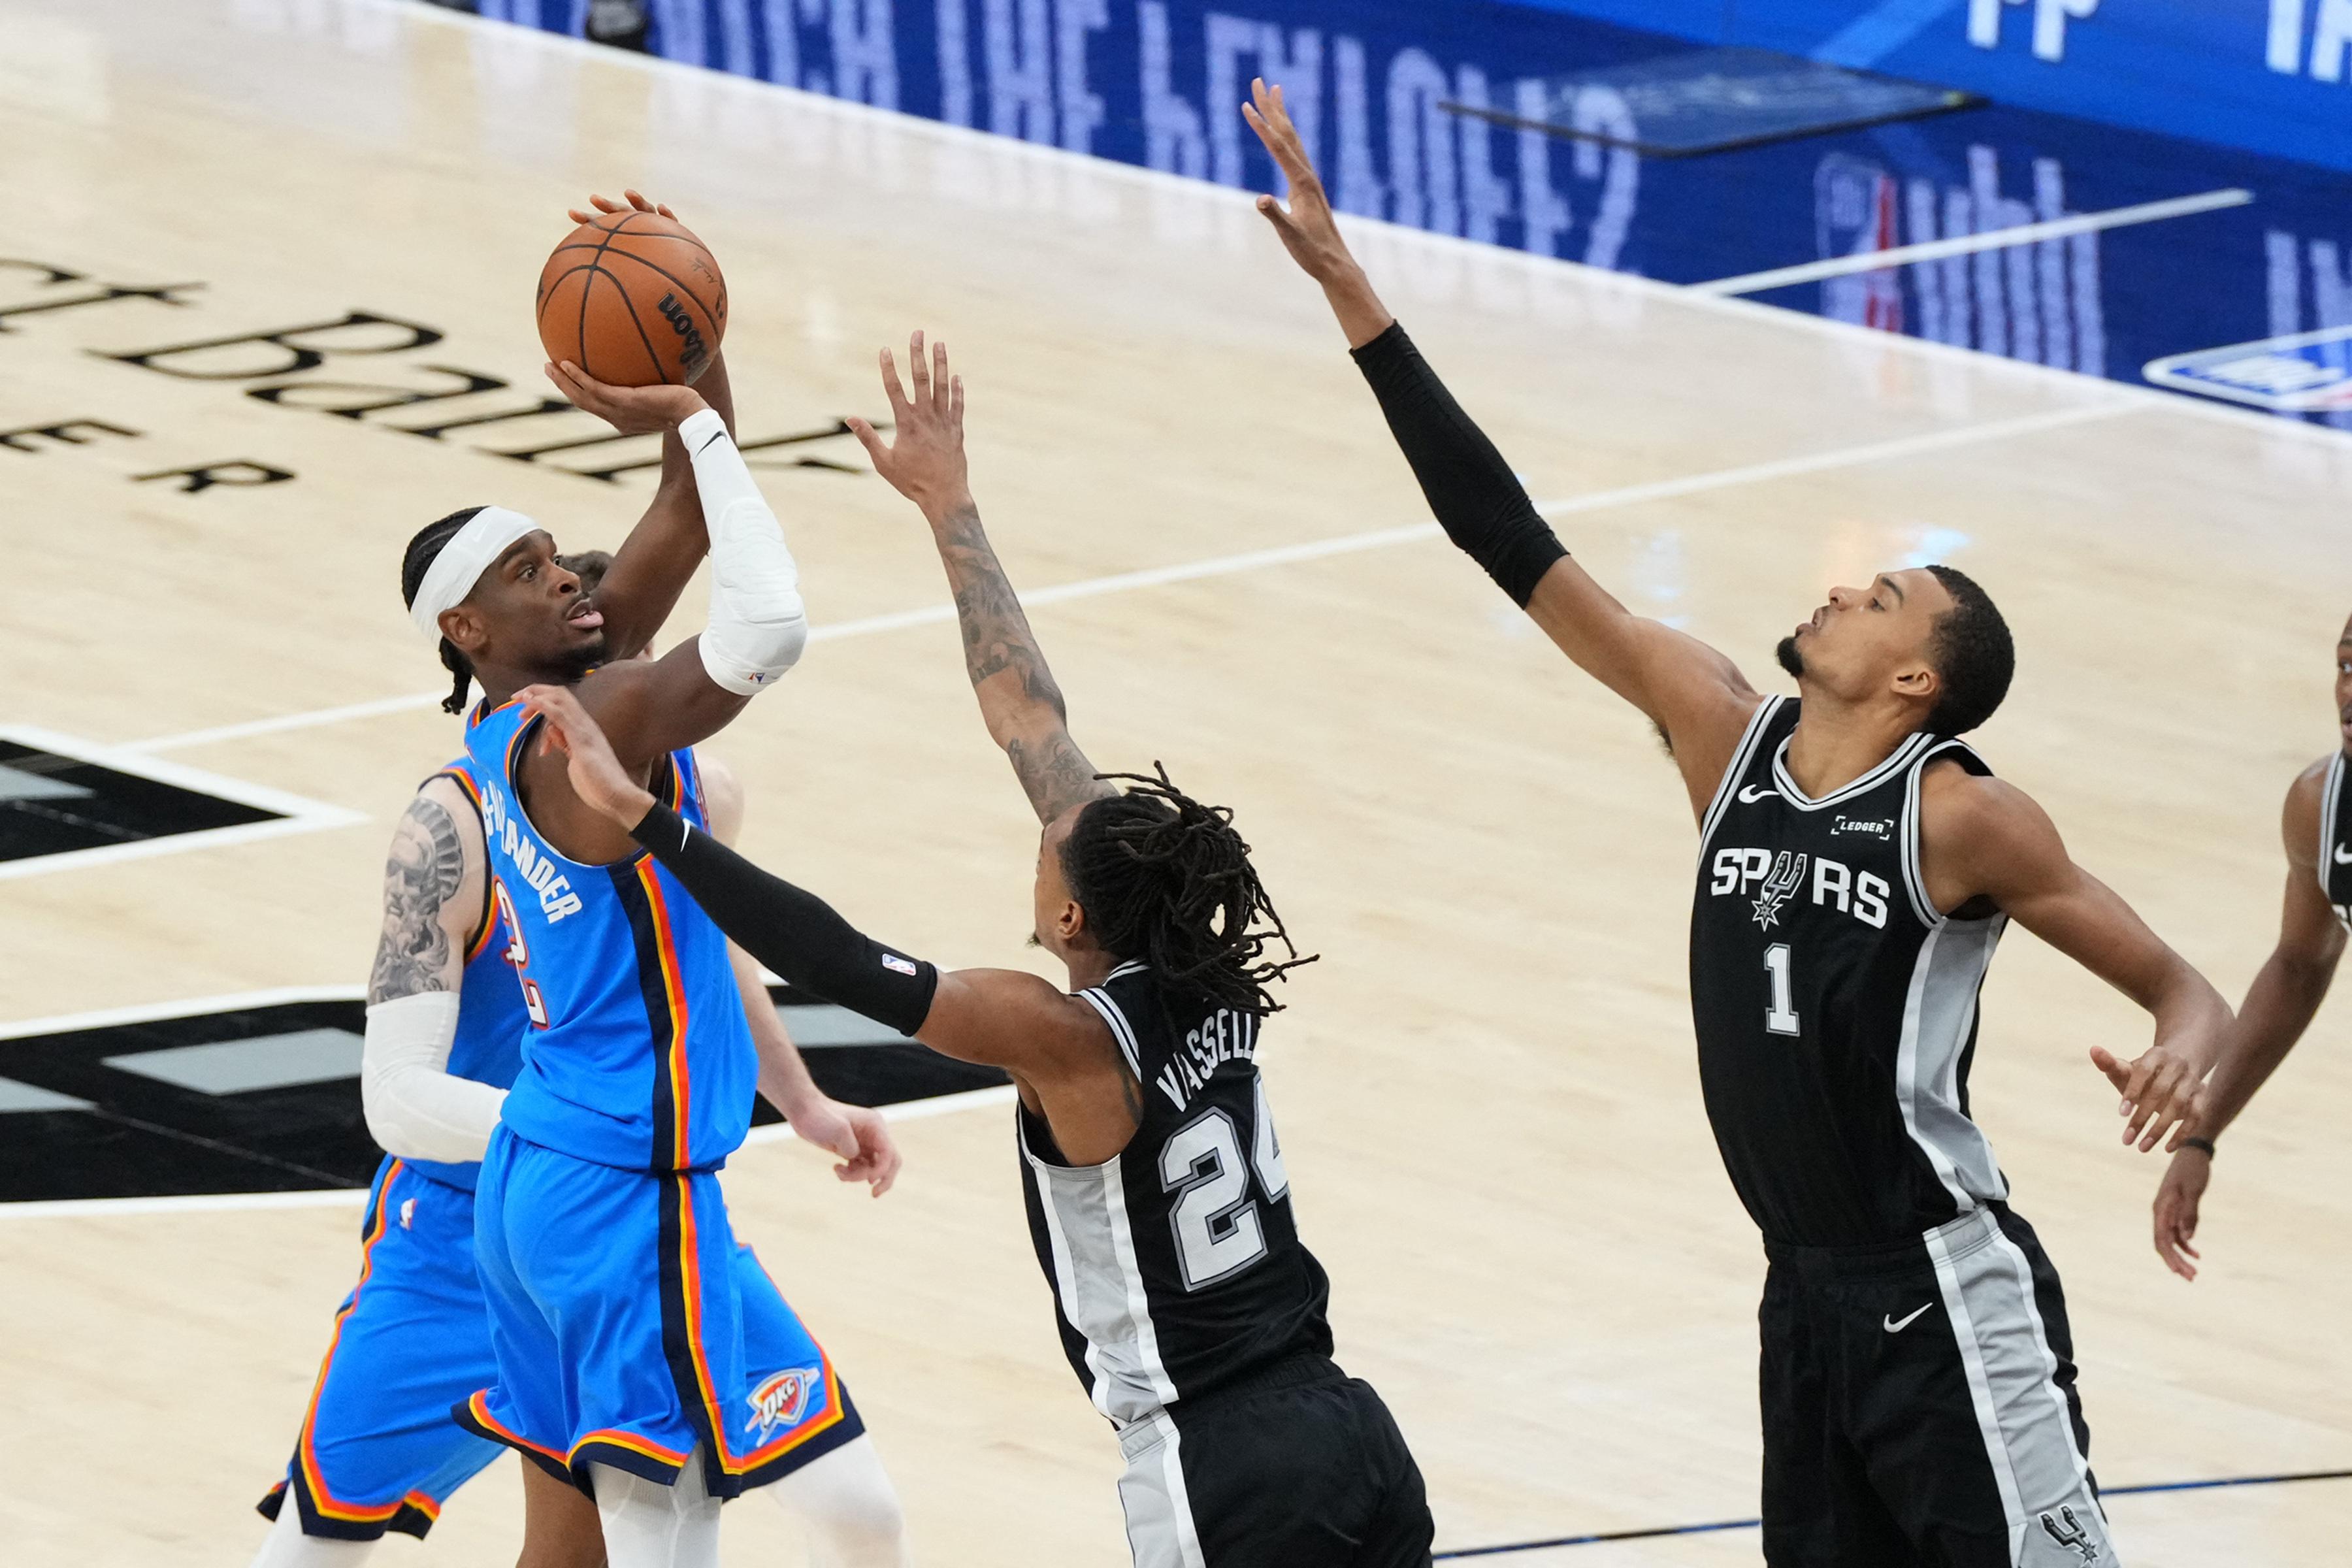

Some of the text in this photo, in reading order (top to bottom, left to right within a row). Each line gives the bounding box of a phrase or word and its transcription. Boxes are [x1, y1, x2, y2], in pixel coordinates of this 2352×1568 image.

[1839, 821, 1884, 834] LEDGER
[1710, 847, 1891, 932] SPURS
[1764, 942, 1801, 1037] 1
[1156, 1008, 1253, 1113] VASSELL
[1158, 1065, 1292, 1292] 24
[762, 1378, 796, 1426] OKC
